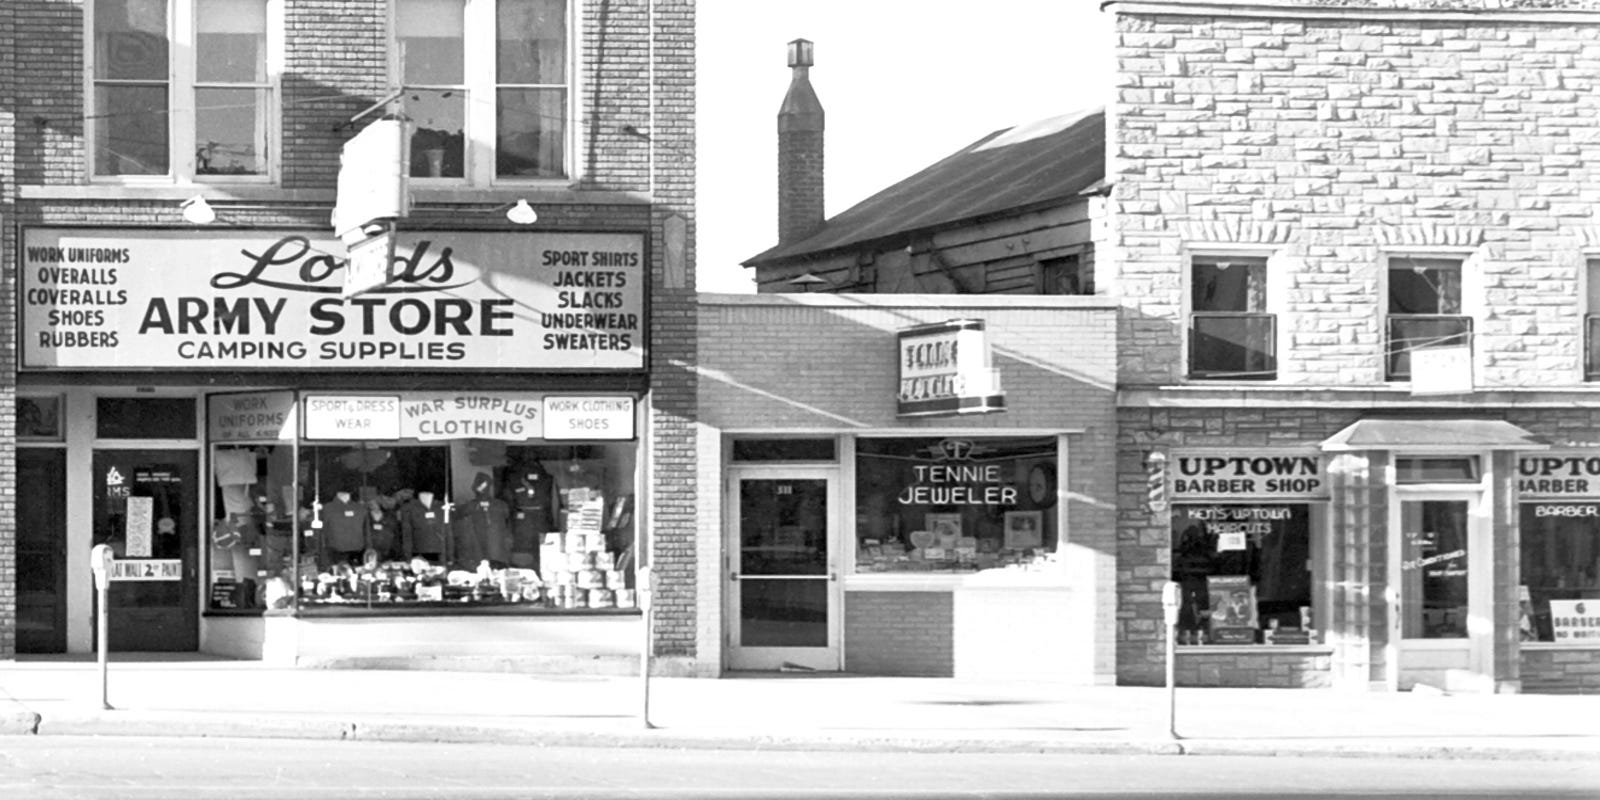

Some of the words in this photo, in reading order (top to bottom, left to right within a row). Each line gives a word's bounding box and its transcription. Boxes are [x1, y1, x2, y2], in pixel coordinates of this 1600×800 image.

[28, 248, 64, 262] WORK
[69, 248, 129, 262] UNIFORMS
[542, 250, 588, 267] SPORT
[592, 252, 639, 267] SHIRTS
[210, 235, 480, 293] Lods
[38, 268, 117, 285] OVERALLS
[553, 271, 626, 287] JACKETS
[28, 290, 127, 305] COVERALLS
[557, 292, 623, 309] SLACKS
[48, 310, 104, 326] SHOES
[138, 298, 287, 335] ARMY
[309, 299, 514, 336] STORE
[541, 313, 638, 329] UNDERWEAR
[39, 331, 119, 348] RUBBERS
[543, 334, 632, 351] SWEATERS
[177, 341, 307, 359] CAMPING
[319, 342, 466, 360] SUPPLIES
[311, 400, 348, 412] SPORT
[356, 400, 395, 412] DRESS
[405, 398, 446, 418] WAR
[454, 395, 537, 420] SURPLUS
[549, 400, 579, 412] WORK
[582, 400, 631, 412] CLOTHING
[219, 412, 284, 428] UNIFORMS
[335, 418, 372, 429] WEAR
[419, 420, 524, 435] CLOTHING
[569, 418, 609, 430] SHOES
[914, 465, 1001, 482] TENNIE
[1179, 457, 1319, 475] UPTOWN
[1175, 479, 1255, 493] BARBER
[1265, 479, 1321, 493] SHOP
[898, 486, 1018, 505] JEWELER
